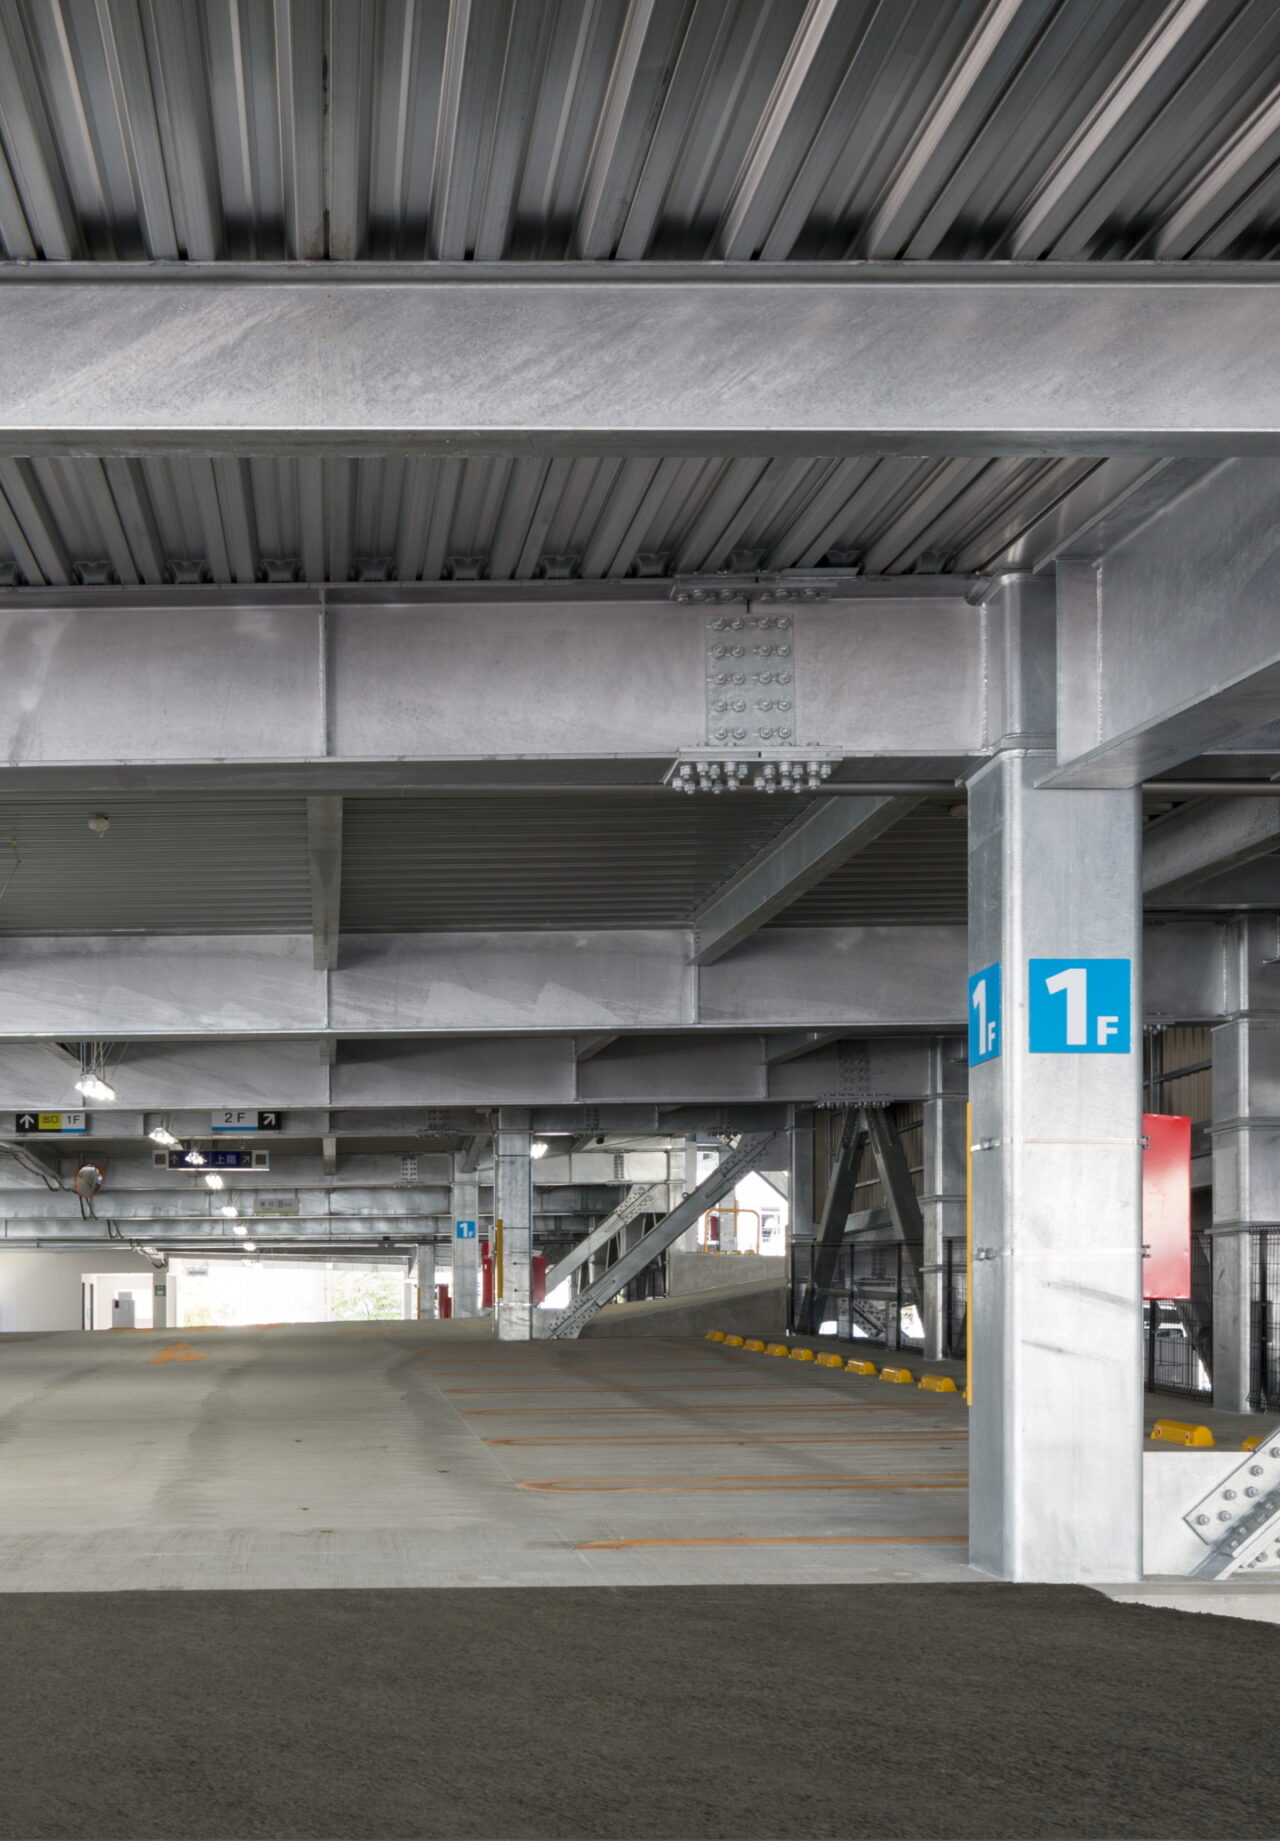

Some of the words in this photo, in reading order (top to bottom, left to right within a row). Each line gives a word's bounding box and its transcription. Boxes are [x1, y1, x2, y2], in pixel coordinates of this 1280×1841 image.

[972, 979, 996, 1055] 1F
[1045, 968, 1119, 1045] 1F
[42, 1115, 59, 1124] 出口
[67, 1115, 81, 1124] 1F
